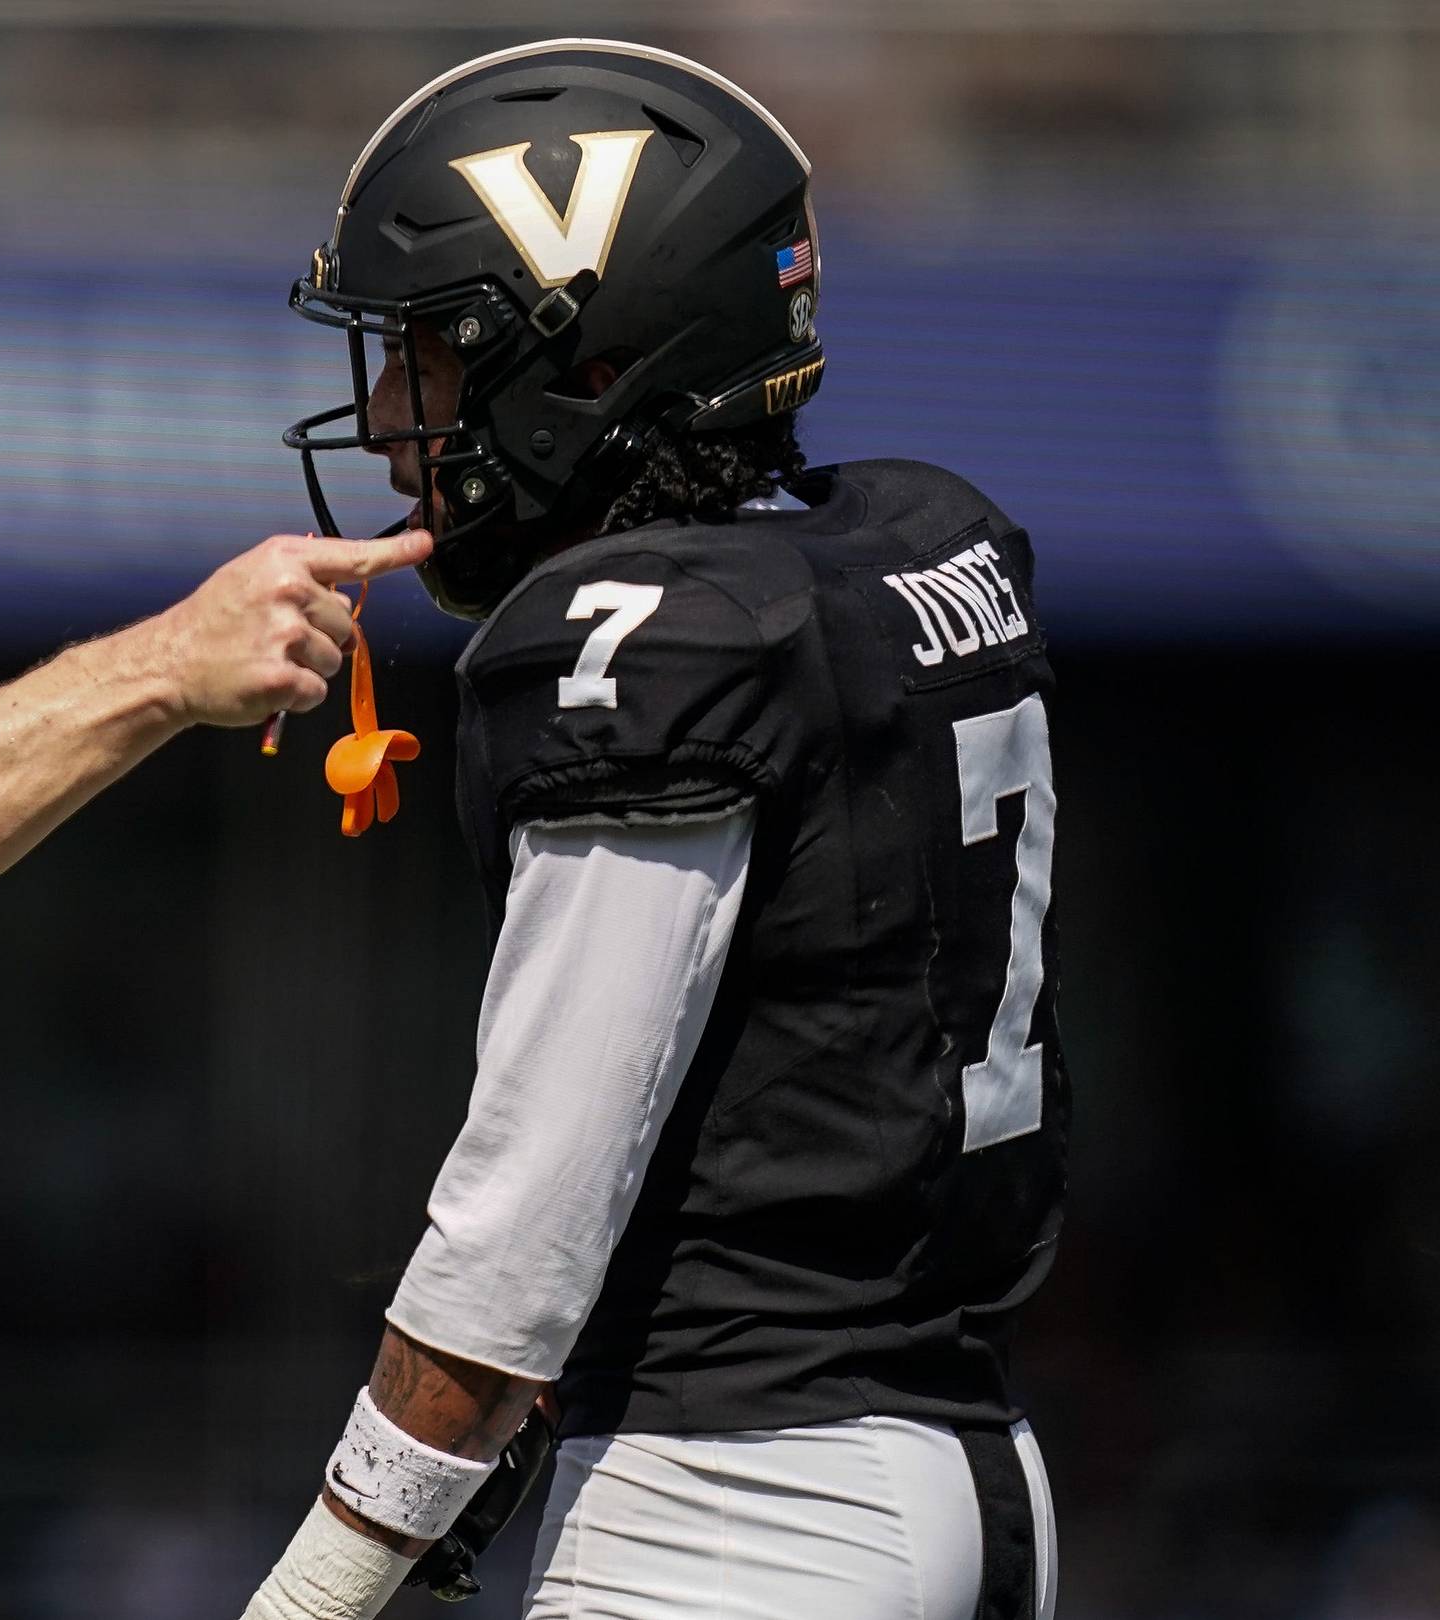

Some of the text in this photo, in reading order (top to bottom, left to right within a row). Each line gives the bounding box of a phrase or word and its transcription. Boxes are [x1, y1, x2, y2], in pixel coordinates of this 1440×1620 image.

[448, 129, 655, 289] V
[558, 580, 664, 709] 7
[882, 540, 1028, 667] JONES
[952, 691, 1057, 1153] 7
